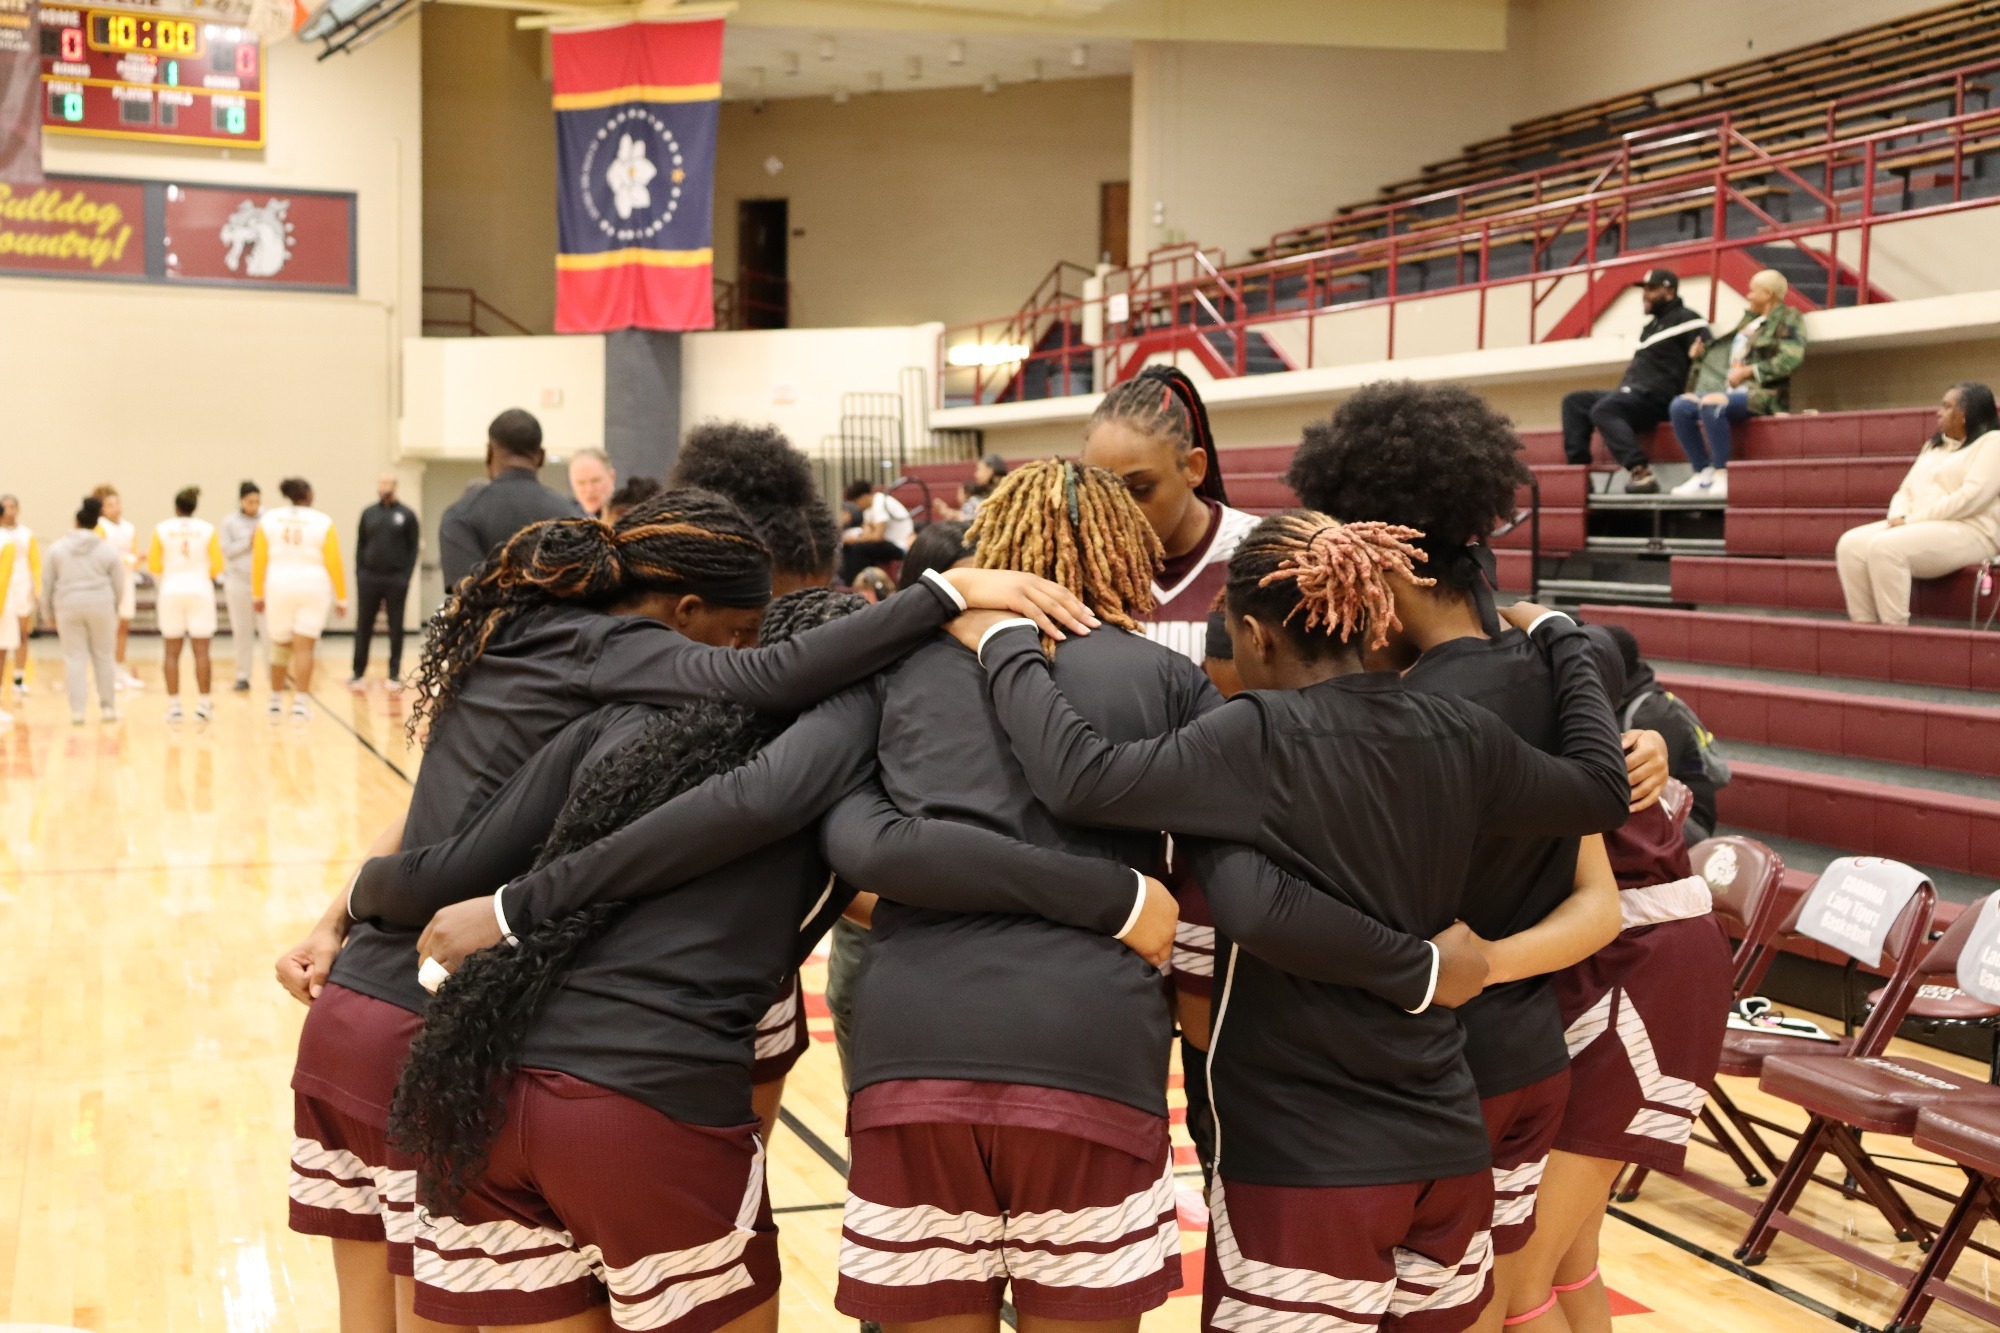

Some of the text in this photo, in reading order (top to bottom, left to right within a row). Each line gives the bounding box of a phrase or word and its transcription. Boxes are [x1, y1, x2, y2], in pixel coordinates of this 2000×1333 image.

[62, 28, 83, 62] 0
[109, 15, 196, 54] 10:00
[235, 43, 257, 77] 0
[64, 93, 83, 121] 0
[227, 106, 246, 134] 0
[0, 226, 132, 268] ountry!
